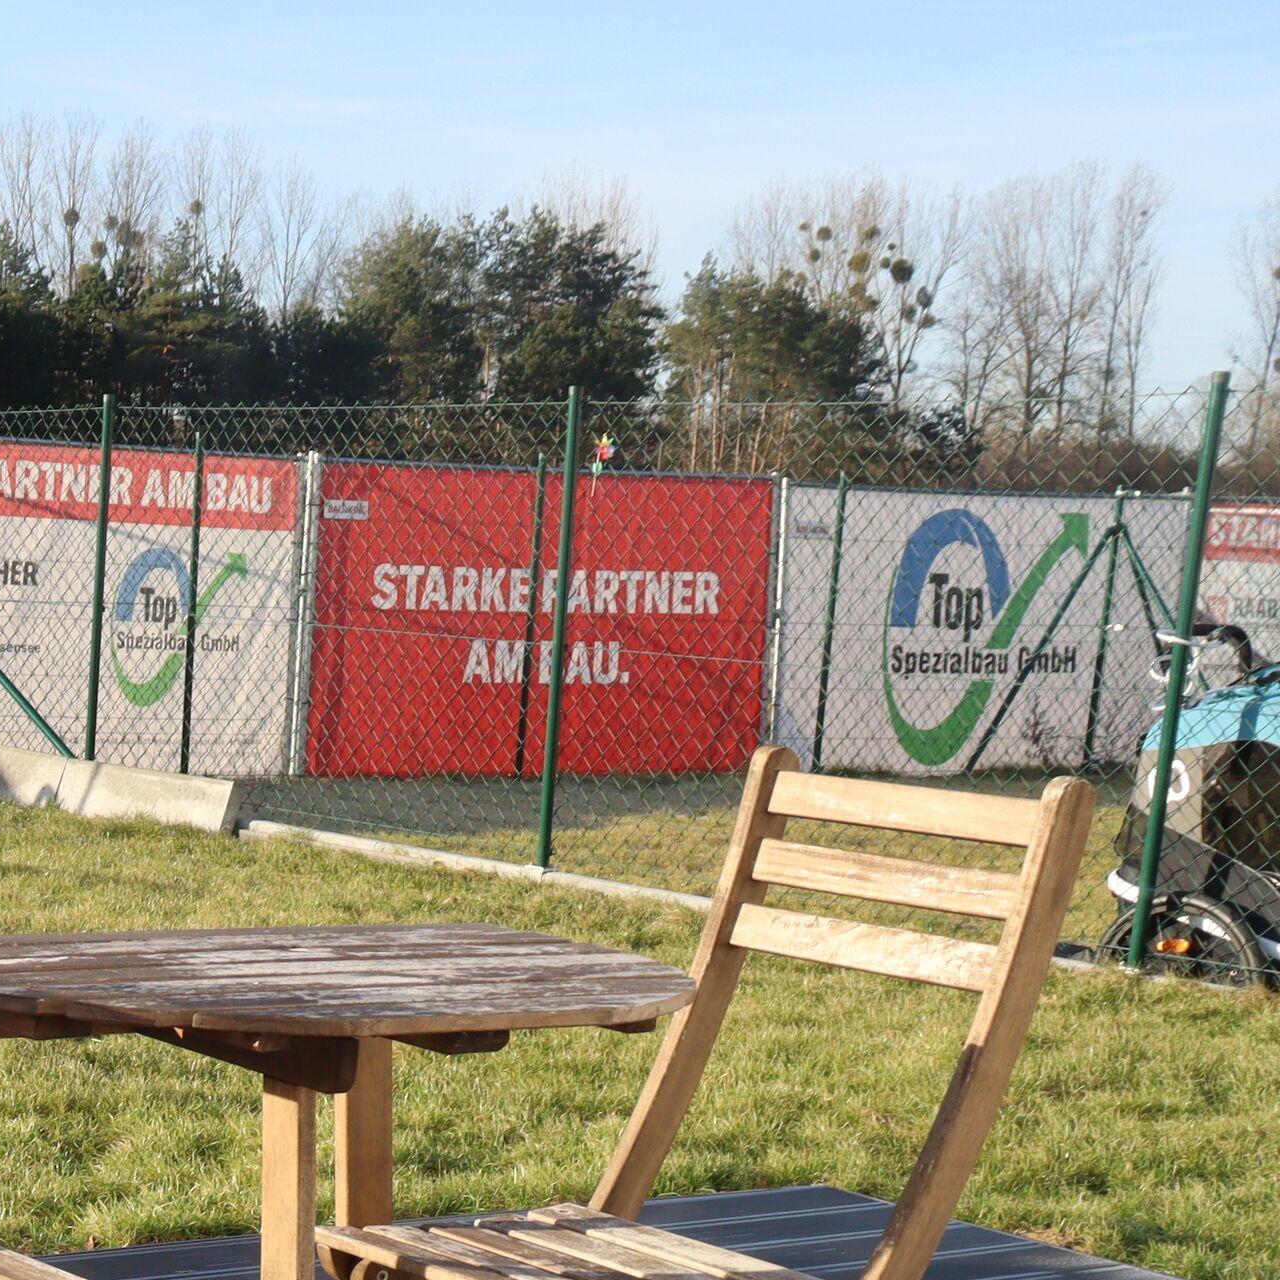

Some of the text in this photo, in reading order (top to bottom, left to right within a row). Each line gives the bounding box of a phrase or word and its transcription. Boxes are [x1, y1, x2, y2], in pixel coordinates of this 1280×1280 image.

[140, 468, 197, 509] AM
[206, 471, 273, 514] BAU
[140, 586, 177, 630] Top
[371, 563, 720, 614] STARKE PARTNER
[929, 573, 984, 643] Top
[117, 631, 240, 654] Spezialba GmbH
[463, 638, 526, 684] AM
[891, 645, 1008, 680] Spezialbau
